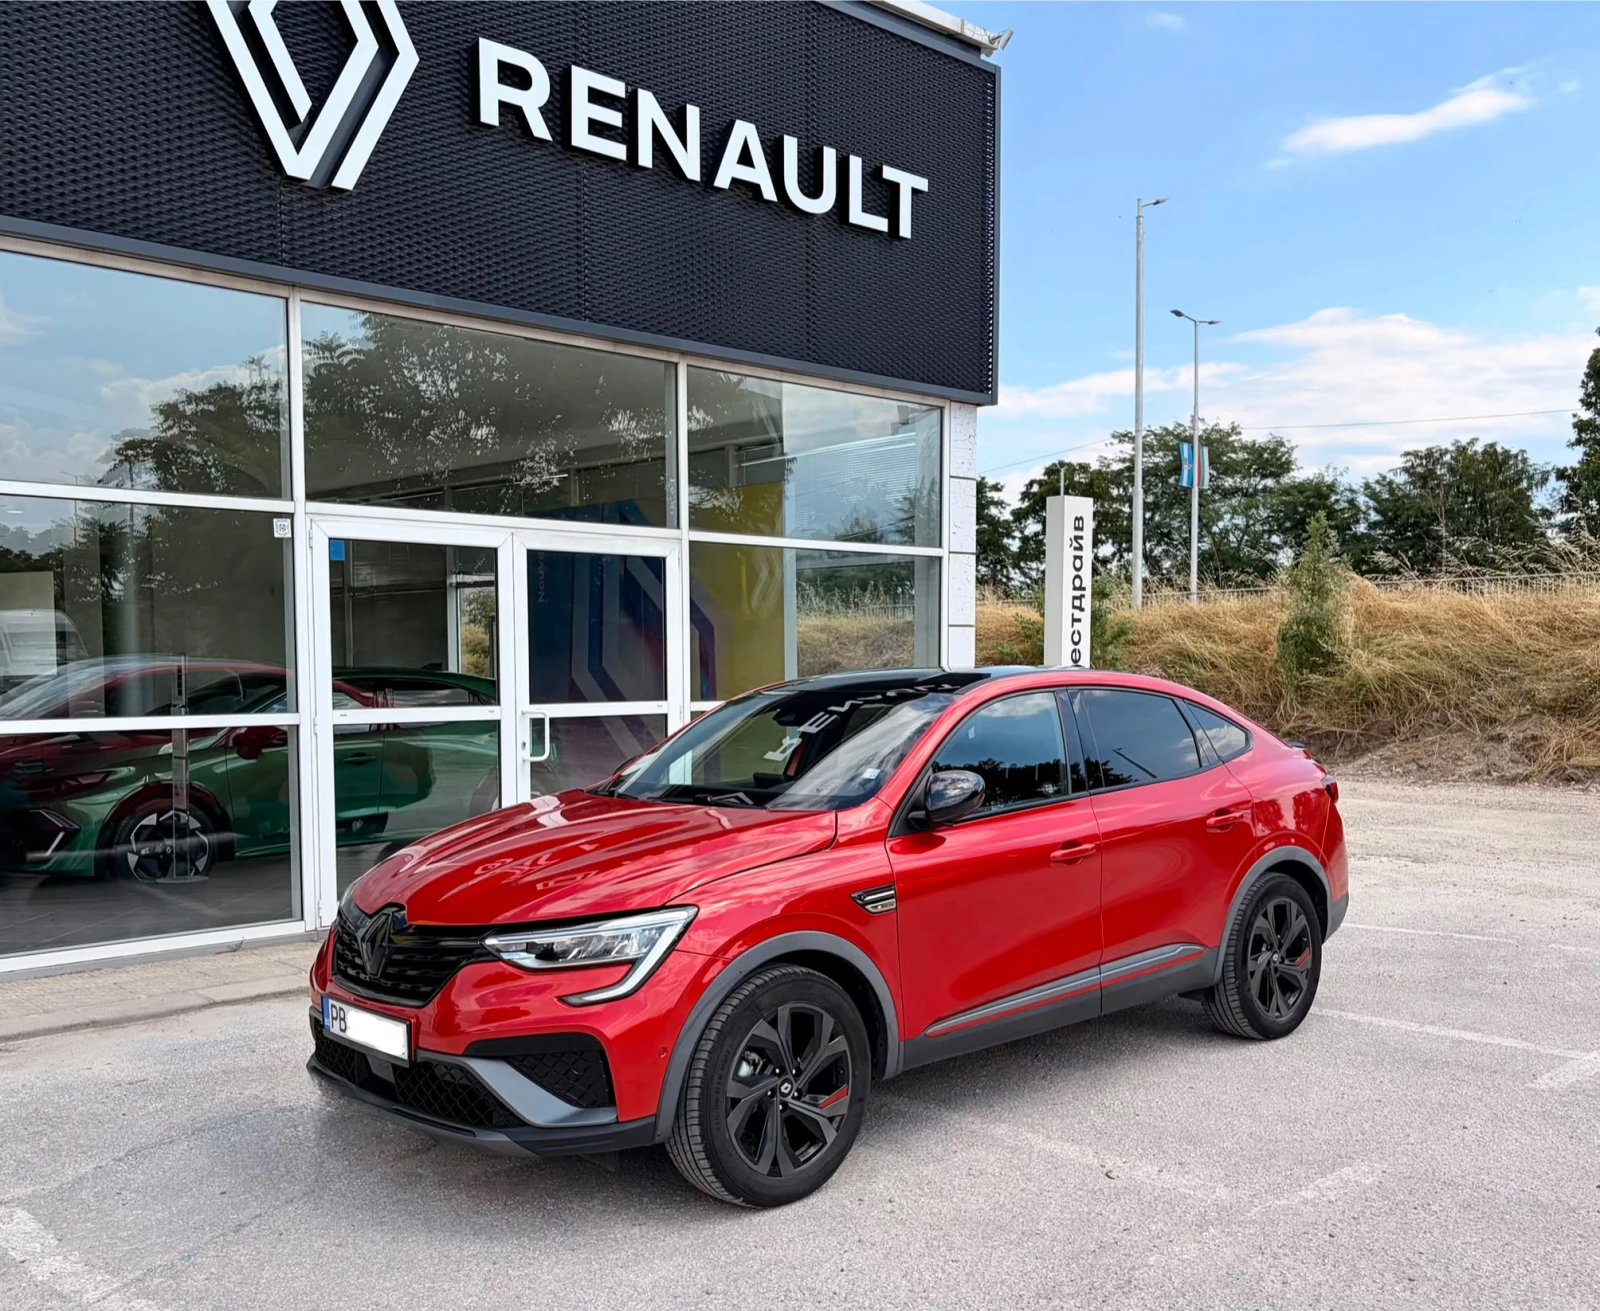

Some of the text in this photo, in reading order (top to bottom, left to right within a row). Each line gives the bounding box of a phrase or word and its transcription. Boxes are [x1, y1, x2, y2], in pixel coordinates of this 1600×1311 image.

[478, 37, 929, 239] RENAULT
[1069, 515, 1087, 667] естдрайв
[330, 1003, 347, 1034] PB
